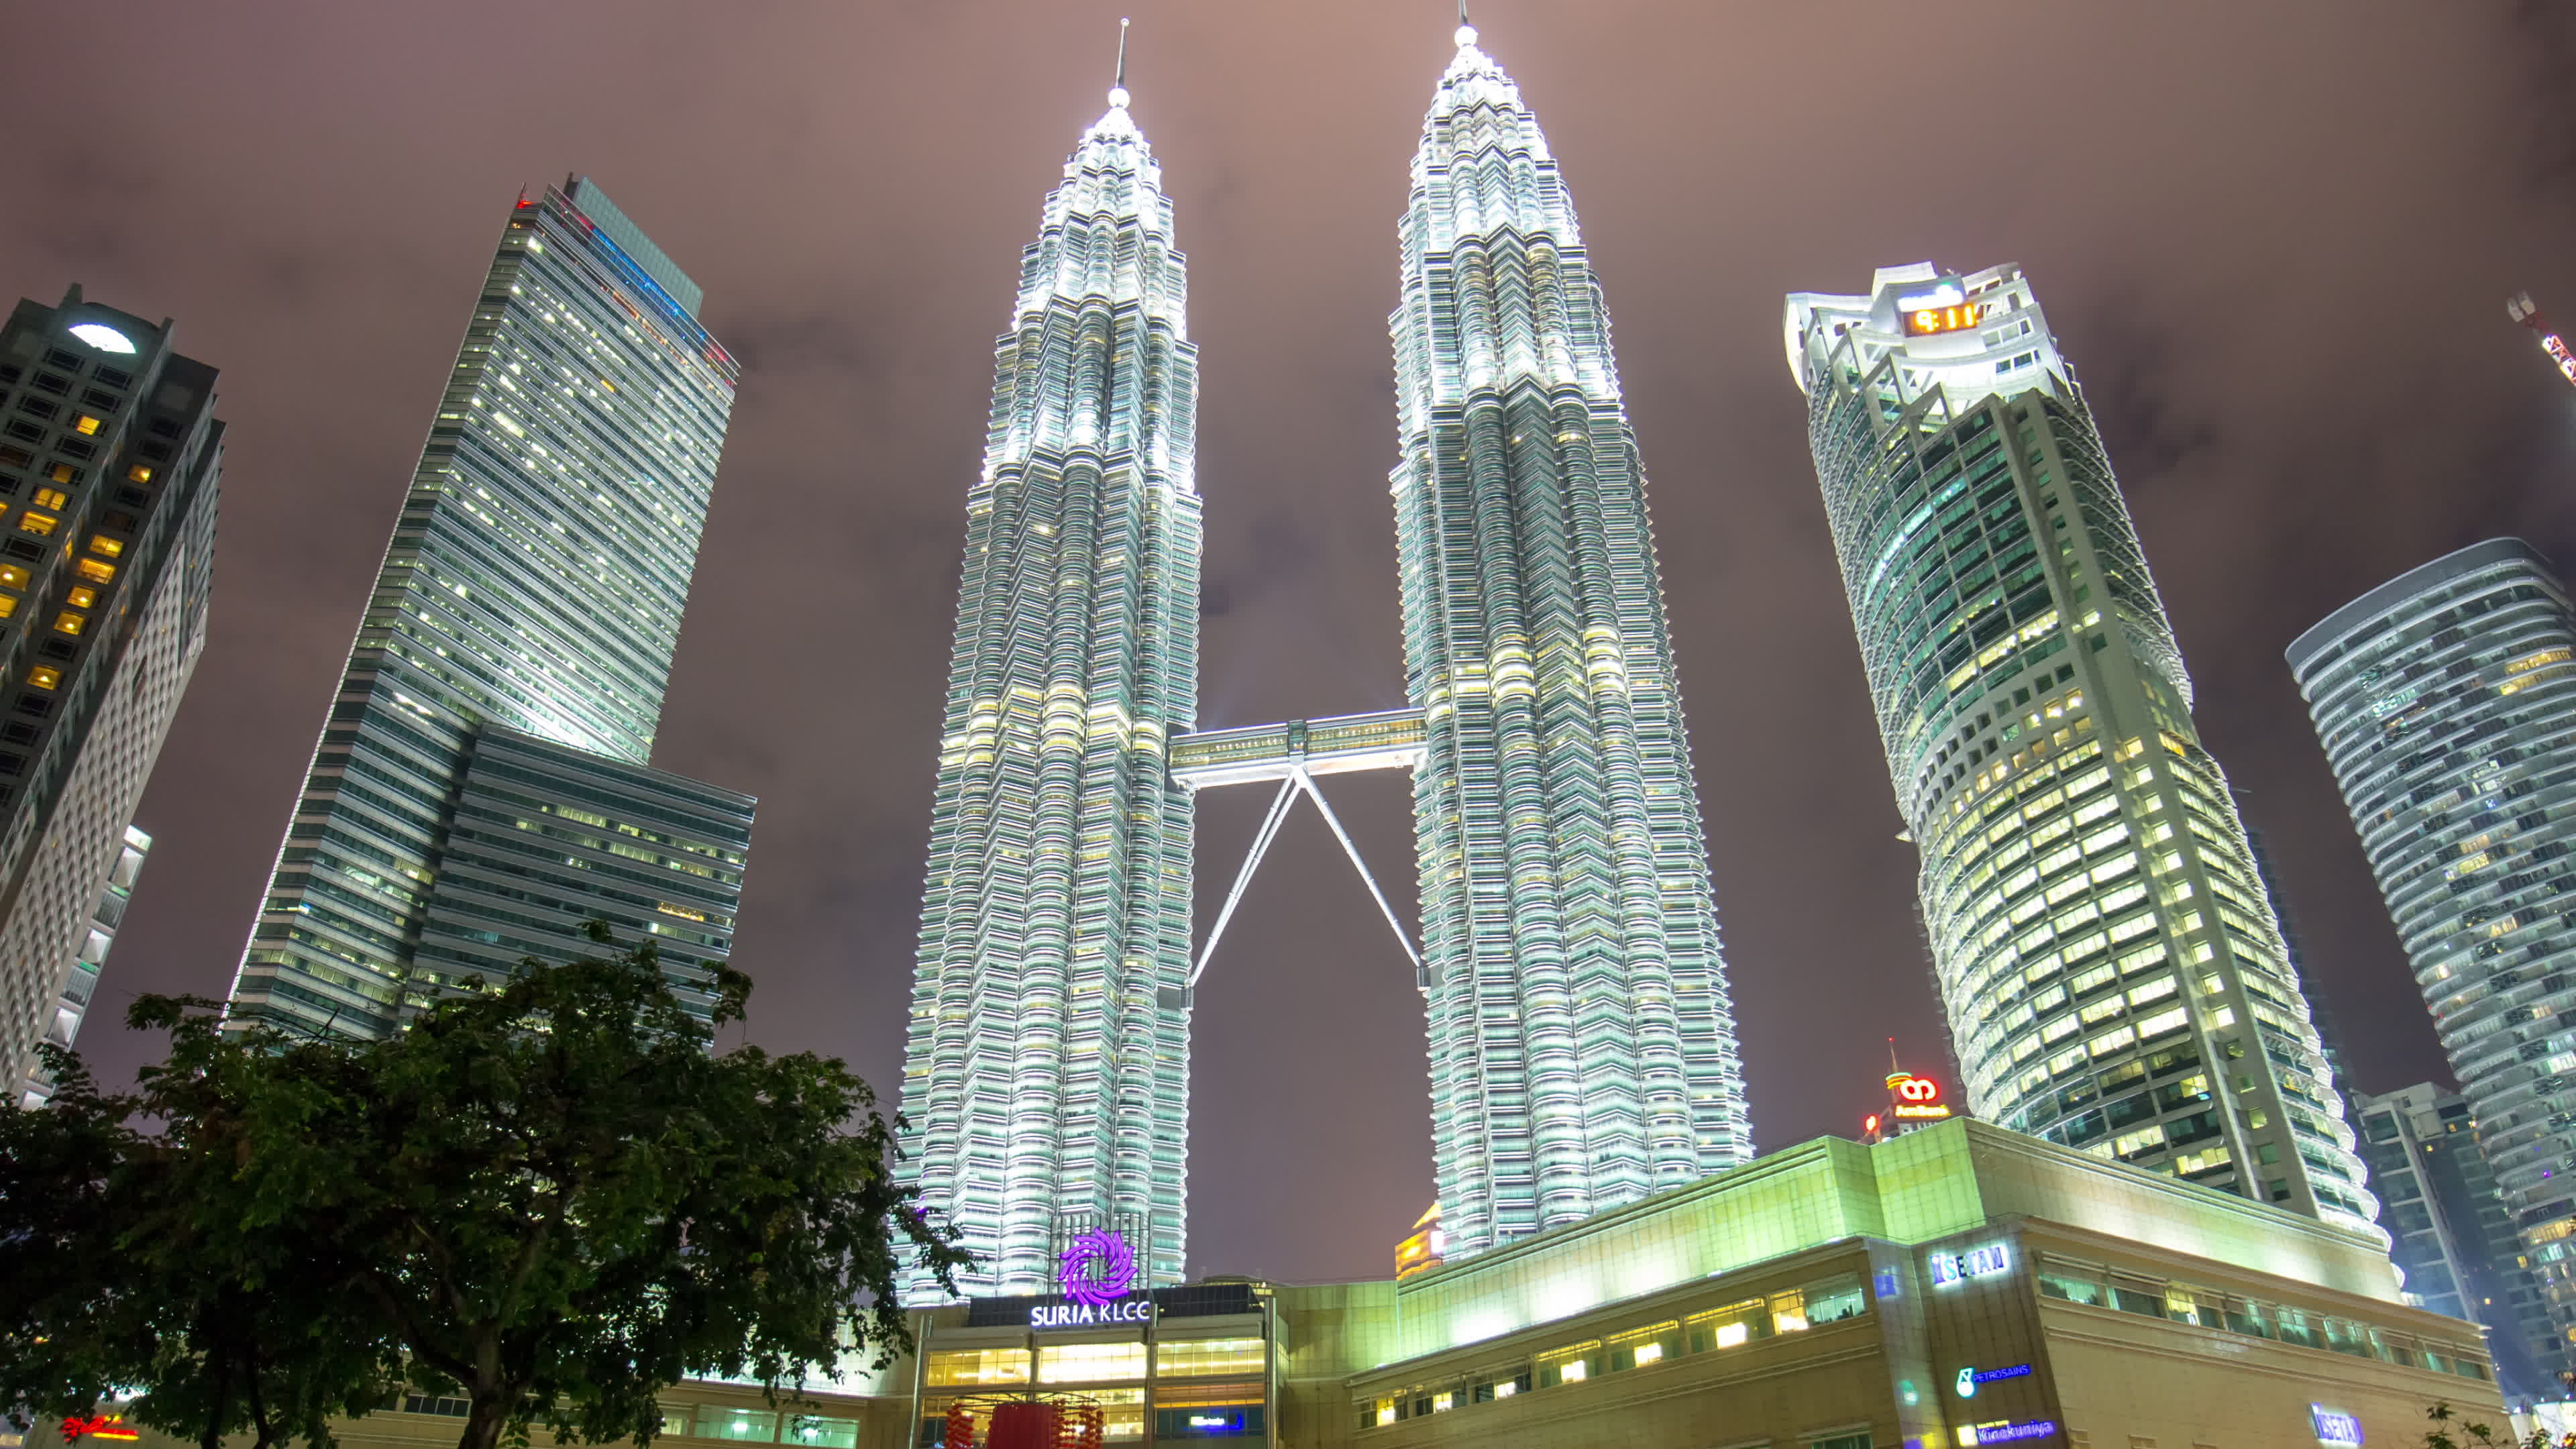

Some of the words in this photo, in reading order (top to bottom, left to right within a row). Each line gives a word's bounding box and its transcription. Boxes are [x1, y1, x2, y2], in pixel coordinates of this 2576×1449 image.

[1915, 305, 1975, 332] 9:11
[1031, 1303, 1094, 1326] SURIA
[1099, 1301, 1150, 1322] KLCC
[1973, 1364, 2029, 1382] PETROSAINS
[1978, 1419, 2055, 1444] Kinokuniya
